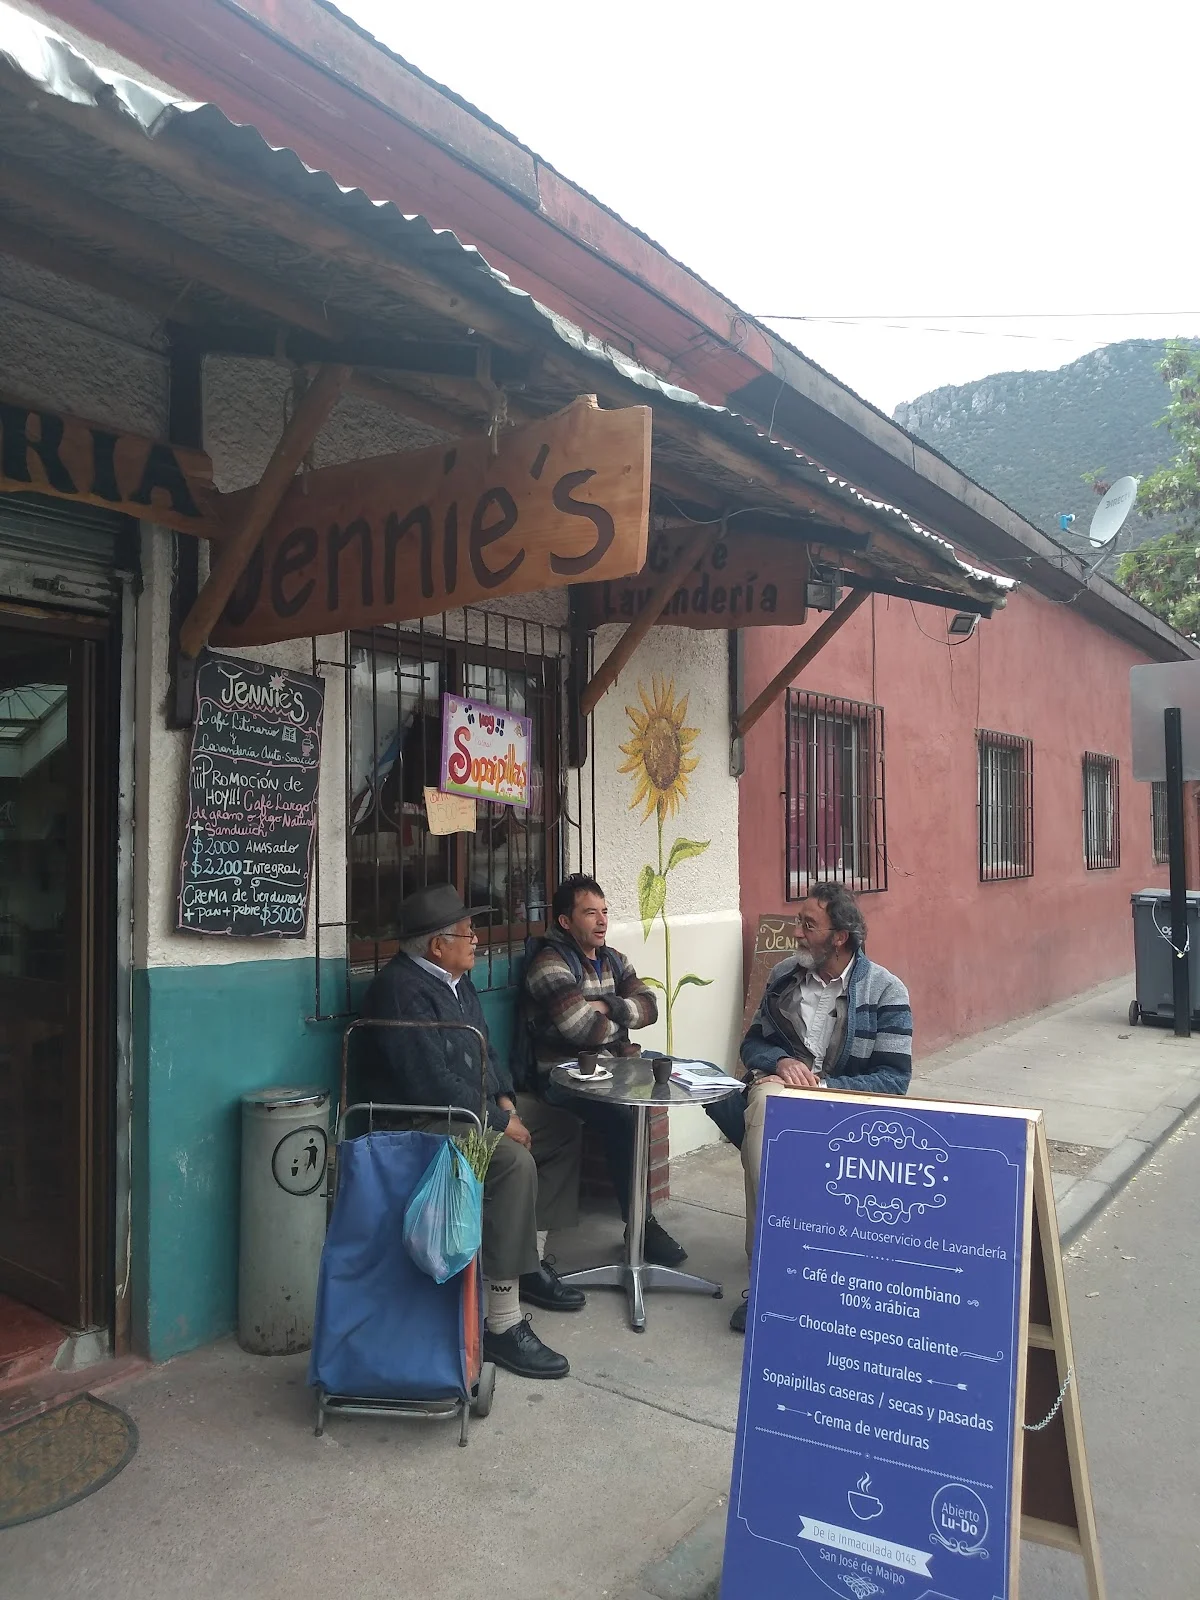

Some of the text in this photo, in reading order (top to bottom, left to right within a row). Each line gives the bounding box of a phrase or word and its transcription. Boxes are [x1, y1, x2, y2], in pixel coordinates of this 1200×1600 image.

[200, 701, 280, 737] Café Literario
[448, 725, 528, 794] Sopaipillas
[284, 776, 304, 792] de
[192, 805, 207, 820] de
[244, 789, 274, 816] Café
[276, 792, 311, 819] Largo
[191, 820, 268, 837] + Sandwich
[192, 836, 239, 856] $2000
[190, 857, 242, 878] $2200
[232, 888, 248, 903] de
[260, 902, 302, 927] $3000
[836, 1156, 936, 1188] JENNIE'S
[767, 1214, 1007, 1261] Café Literario & Autoservicio de Lavandería
[802, 1266, 961, 1306] Café de grano colombiano
[839, 1292, 920, 1319] 100% arábica
[799, 1314, 959, 1357] Chocolate espeso caliente
[826, 1351, 923, 1384] Jugos naturales
[762, 1367, 994, 1432] Sopaipillas caseras / secas y pasadas
[814, 1410, 930, 1450] Crema de verduras
[941, 1502, 980, 1523] Abierto
[941, 1515, 978, 1536] Lu-Do
[813, 1525, 918, 1567] De la Inmaculada 0145
[819, 1548, 905, 1585] San José de Maipo
